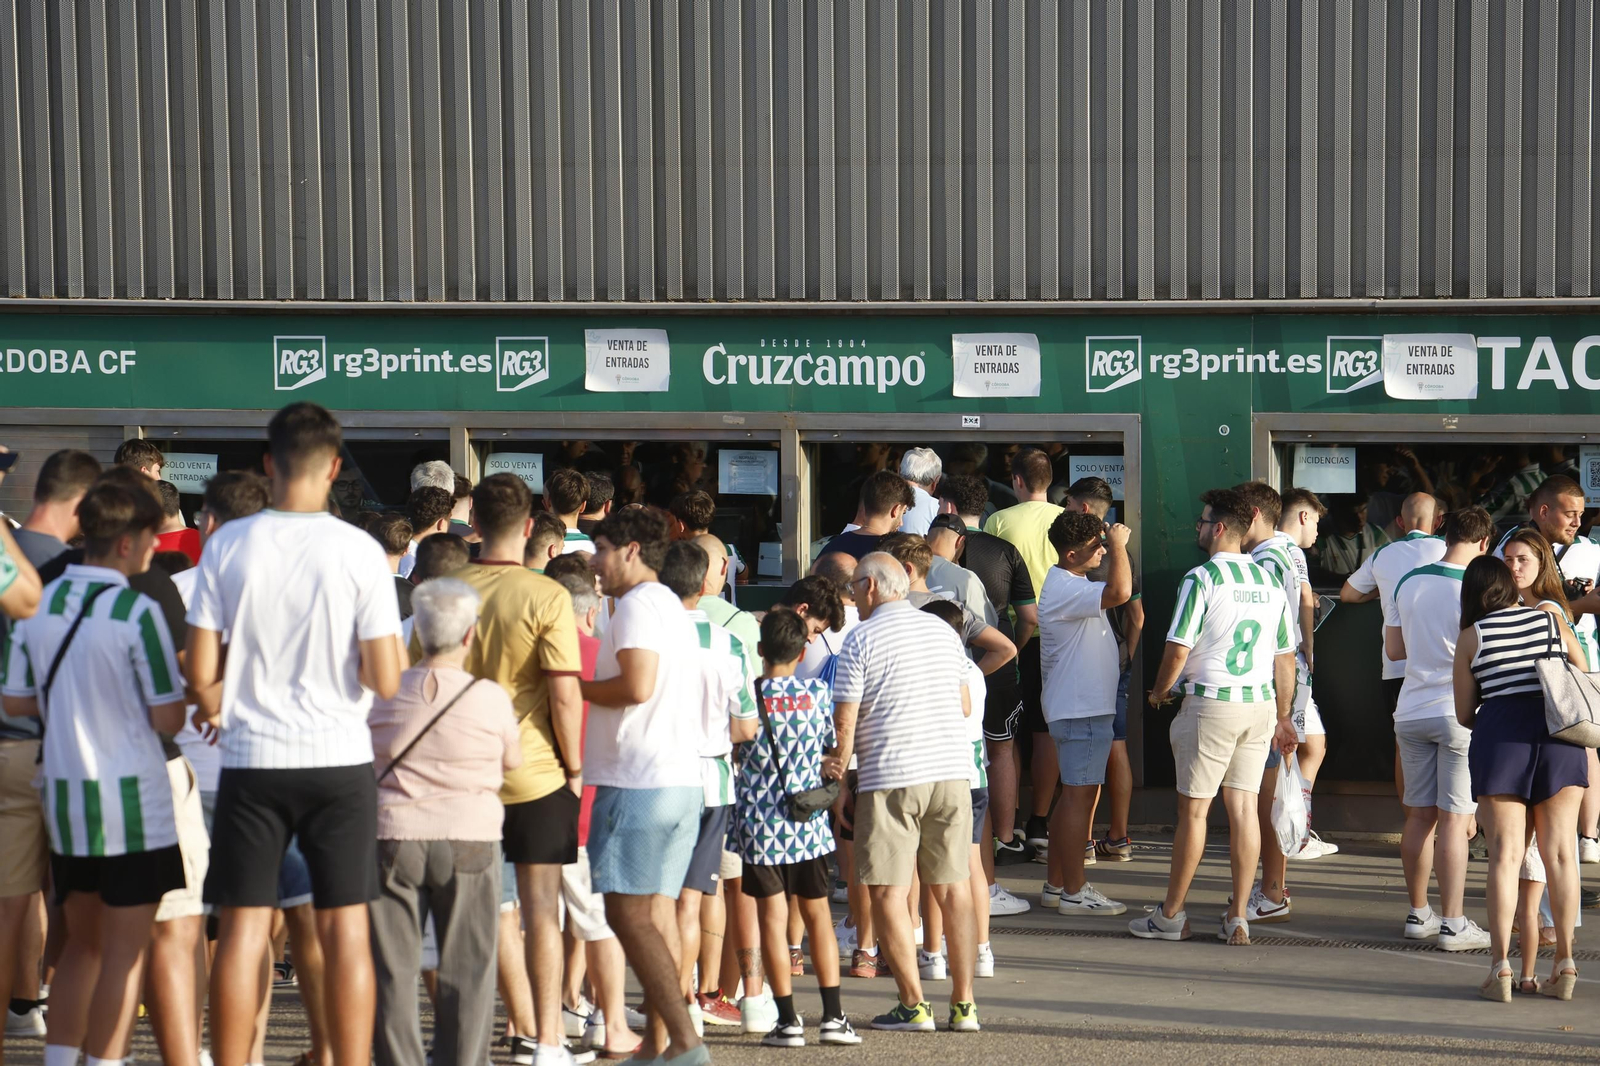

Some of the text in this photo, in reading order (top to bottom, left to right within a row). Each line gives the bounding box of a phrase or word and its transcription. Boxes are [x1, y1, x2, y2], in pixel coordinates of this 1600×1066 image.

[607, 339, 648, 353] VENTA DE
[761, 338, 866, 348] DESDE 1904
[975, 344, 1018, 357] VENTA DE
[1407, 345, 1453, 358] VENTA DE
[0, 348, 137, 375] DOBA CF
[280, 348, 320, 375] RG3
[333, 348, 492, 379] rg3print.es
[501, 350, 543, 376] RG3
[605, 356, 650, 370] ENTRADAS
[702, 342, 926, 393] Cruzcampo
[974, 361, 1020, 375] ENTRADAS
[1091, 349, 1135, 377] RG3
[1149, 348, 1322, 380] rg3print.es
[1332, 350, 1378, 377] RG3
[1406, 363, 1455, 377] ENTRADAS
[165, 460, 212, 470] SOLO VENTA
[490, 460, 537, 469] SOLO VENTA
[1298, 456, 1350, 465] INCIDENCIAS
[1075, 464, 1125, 472] SOLO VENTA
[169, 473, 208, 481] ENTRADAS
[1233, 589, 1271, 604] GUDELJ
[1225, 619, 1262, 677] 8
